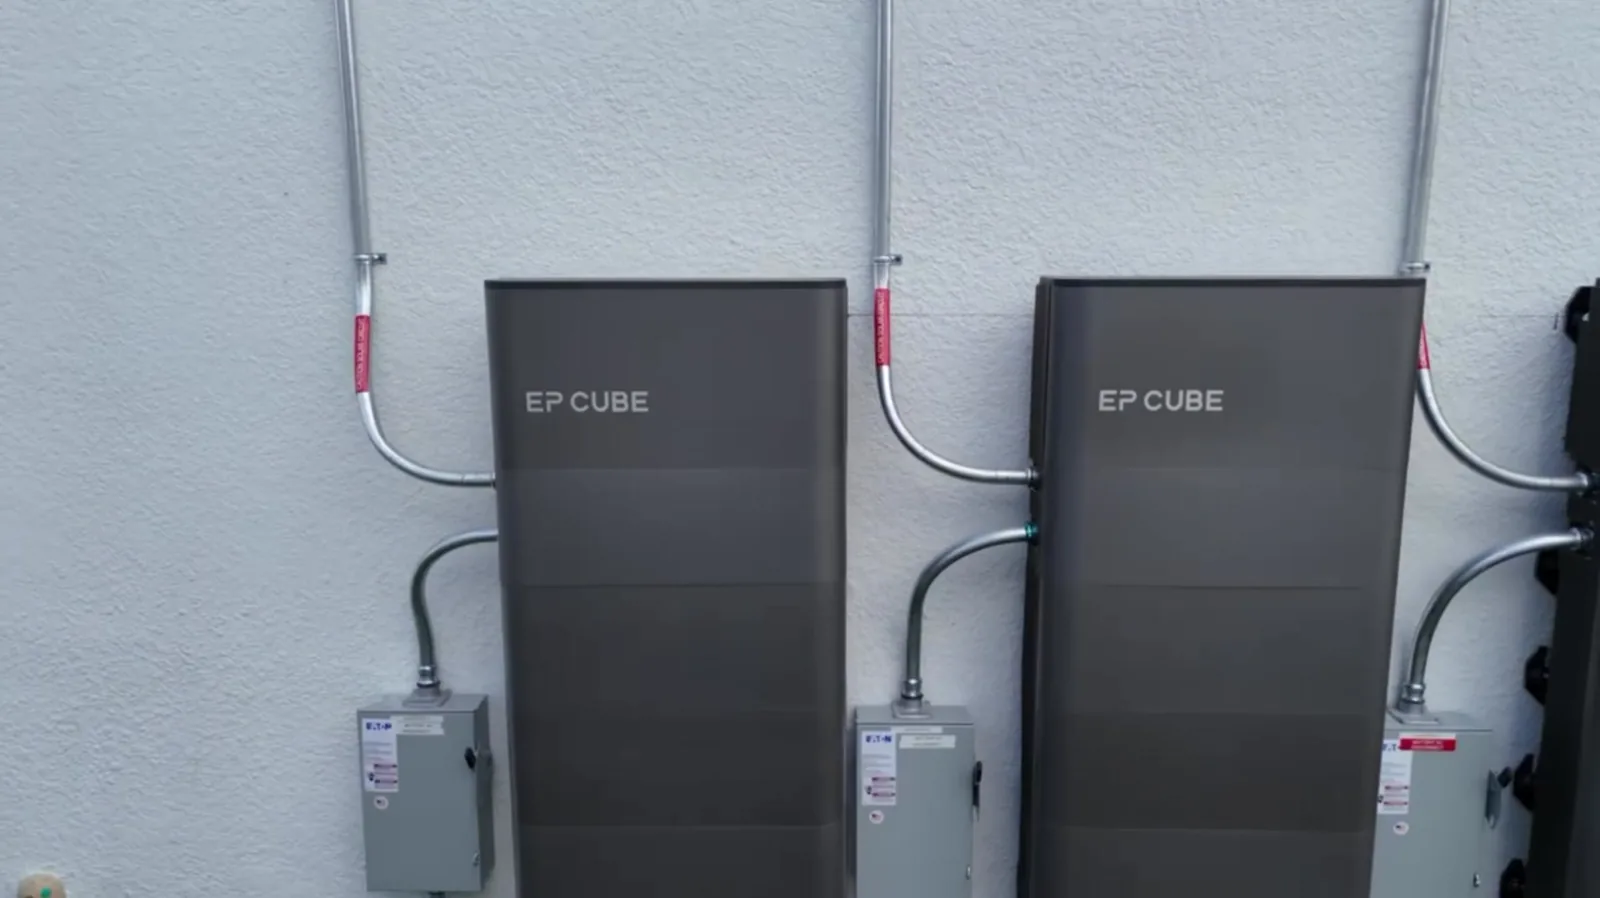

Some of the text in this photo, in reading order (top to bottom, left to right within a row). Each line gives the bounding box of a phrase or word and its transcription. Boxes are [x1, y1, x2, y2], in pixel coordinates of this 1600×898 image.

[526, 391, 649, 413] EP CUBE
[1098, 389, 1224, 411] EP CUBE
